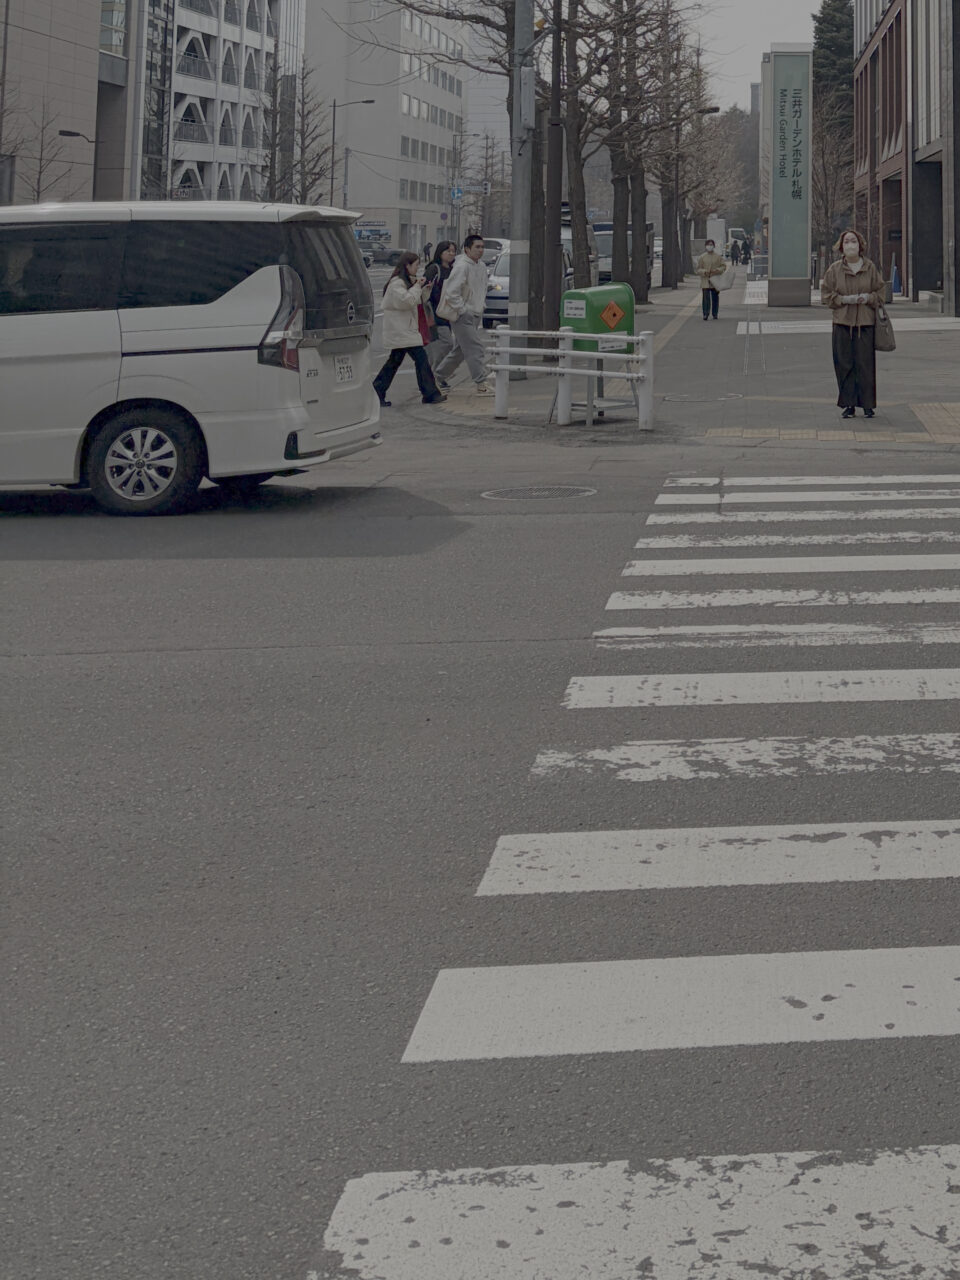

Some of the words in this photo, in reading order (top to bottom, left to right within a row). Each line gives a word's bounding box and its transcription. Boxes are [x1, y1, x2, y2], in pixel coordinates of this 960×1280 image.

[779, 88, 788, 117] Mitsui
[779, 119, 788, 151] Garden
[792, 88, 802, 200] 三井ガーデンホテル札幌
[779, 154, 788, 178] Hotel
